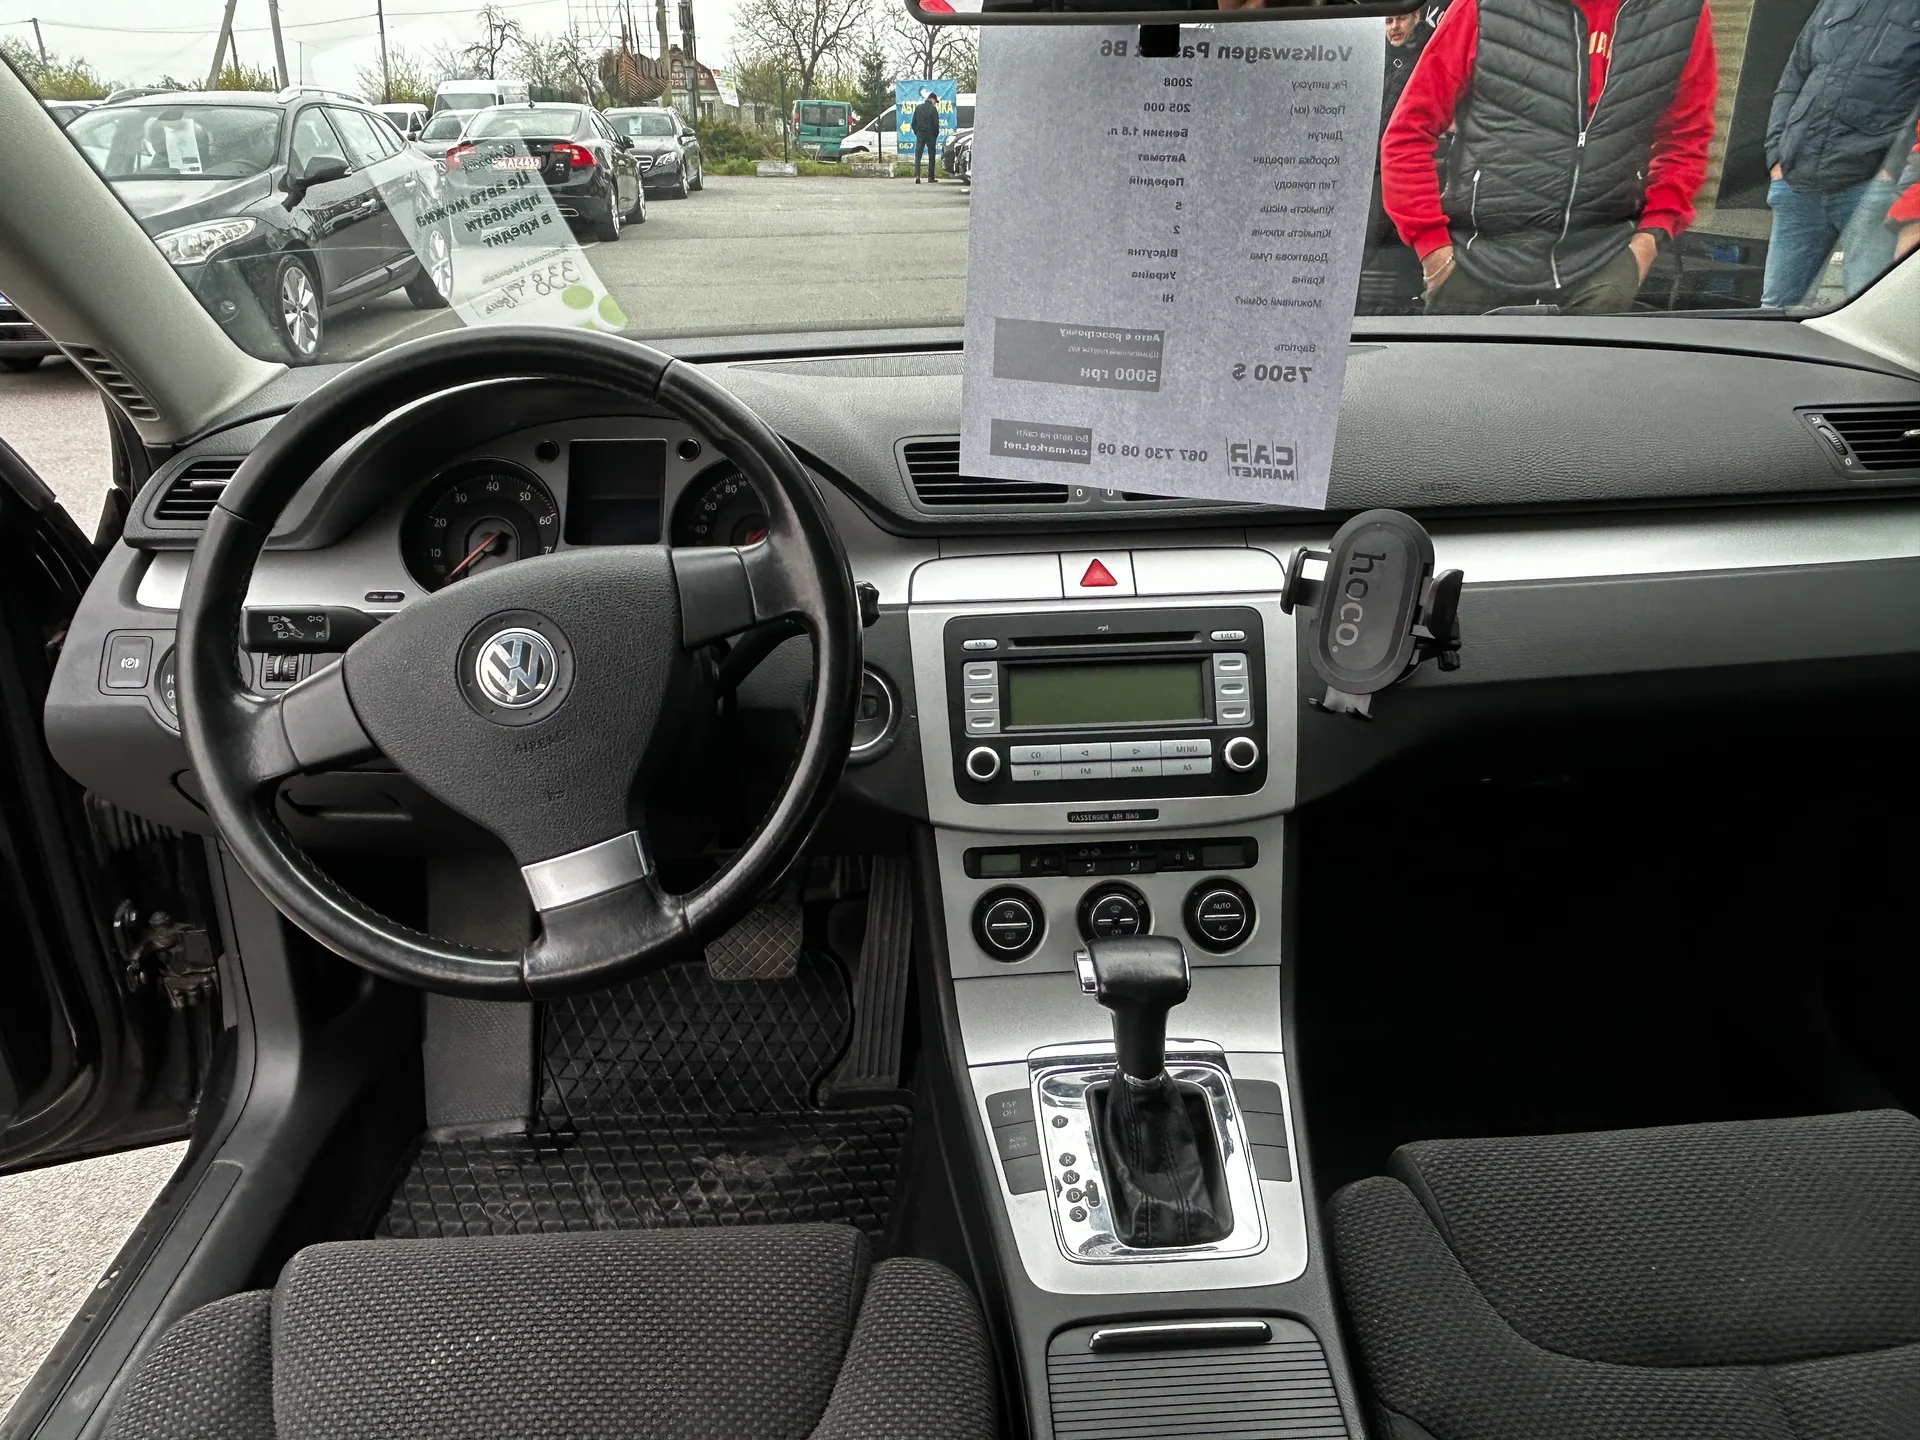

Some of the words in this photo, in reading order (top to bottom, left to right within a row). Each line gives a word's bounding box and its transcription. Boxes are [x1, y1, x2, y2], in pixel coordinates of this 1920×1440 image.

[486, 482, 499, 491] 40
[725, 485, 737, 493] 80
[456, 493, 467, 502] 30
[519, 492, 531, 501] 50
[434, 518, 447, 527] 20
[539, 516, 552, 525] 60
[1213, 902, 1232, 910] AUTO
[1075, 1210, 1083, 1219] S
